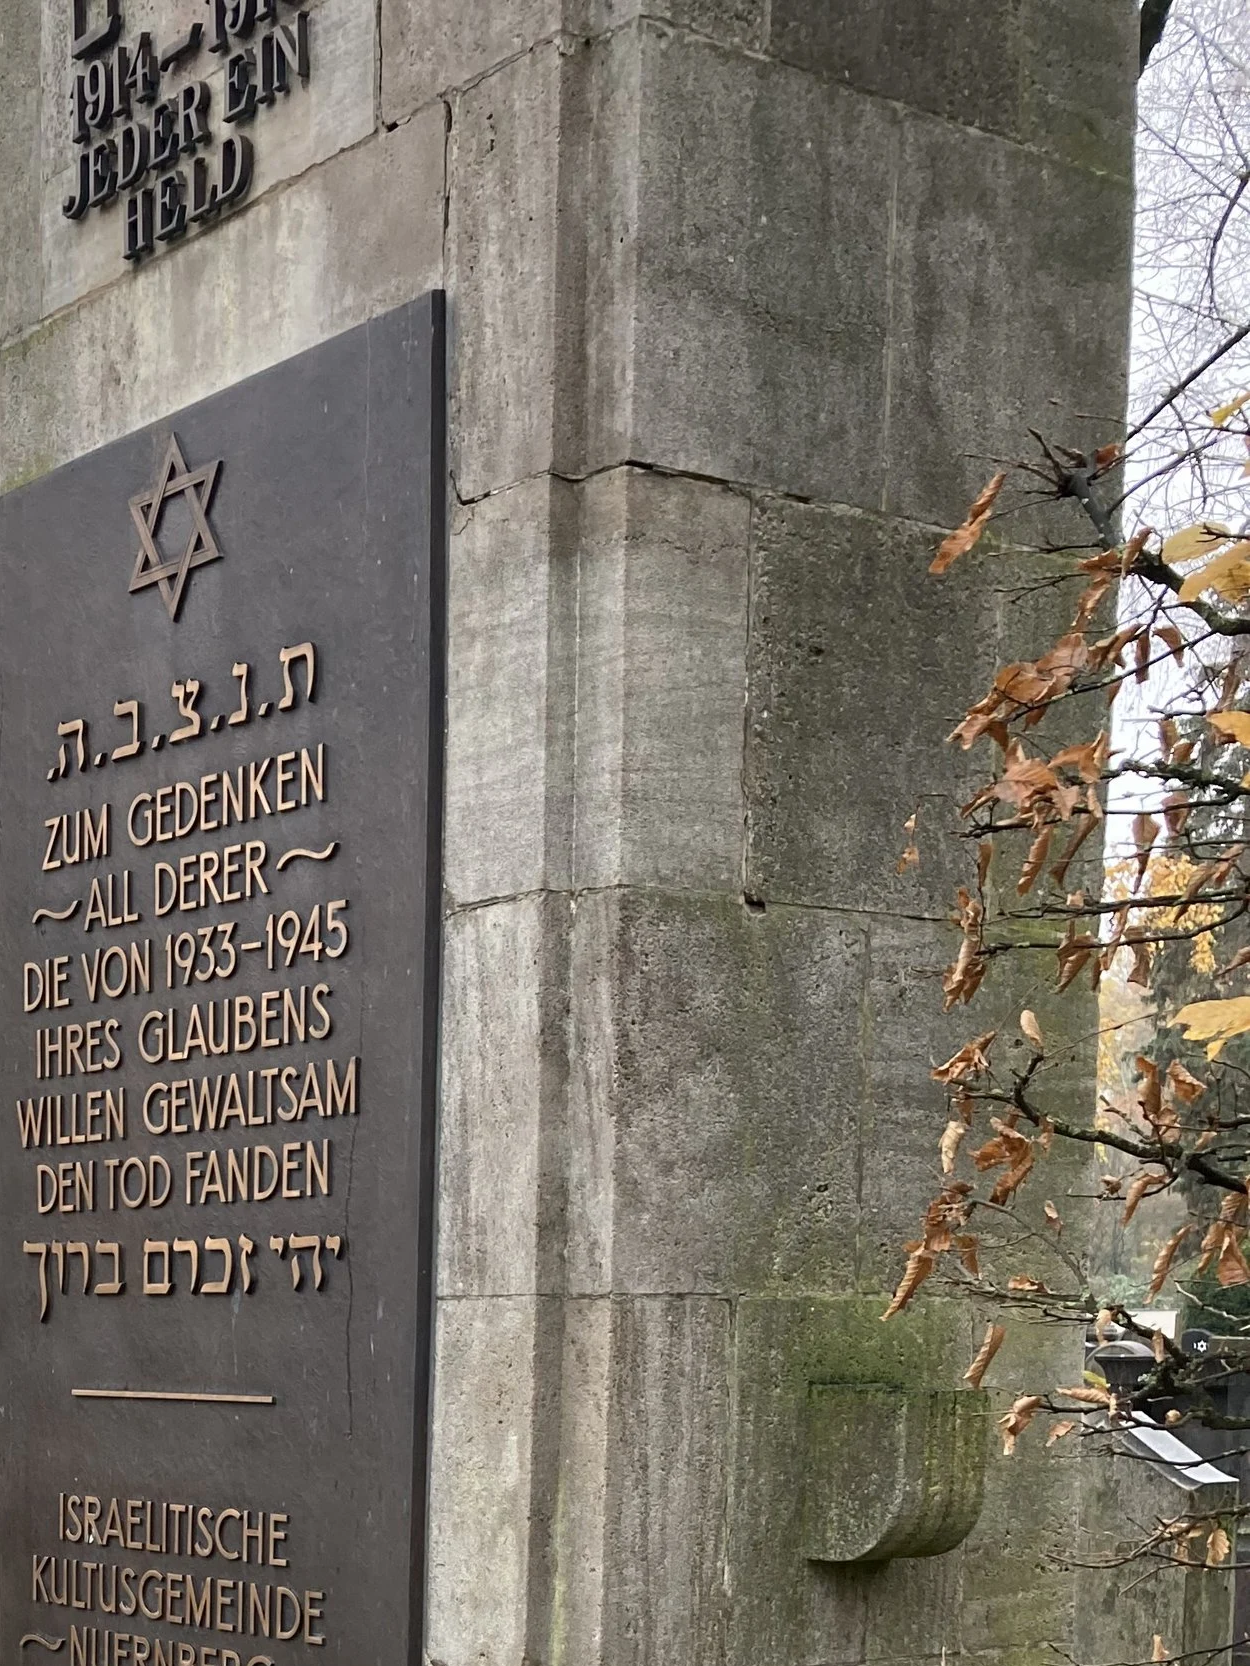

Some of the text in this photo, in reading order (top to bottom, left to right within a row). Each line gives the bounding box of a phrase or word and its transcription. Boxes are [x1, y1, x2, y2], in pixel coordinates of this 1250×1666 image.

[64, 10, 309, 219] JEDER EIN
[123, 135, 253, 260] HELD
[42, 743, 326, 871] ZUM GEDENKEN
[84, 840, 270, 931] ALL DERER
[23, 899, 349, 1012] DIE VON 1933-1945
[36, 983, 333, 1078] IHRES GLAUBENS
[16, 1056, 361, 1148] WILLEN GEWALTSAM
[36, 1139, 330, 1214] DEN TOD FANDEN
[23, 1232, 343, 1323] יהי זכרם ברוך
[58, 1492, 290, 1567] ISRAELITISCHE
[32, 1554, 327, 1645] KULTUSGEMEINDE
